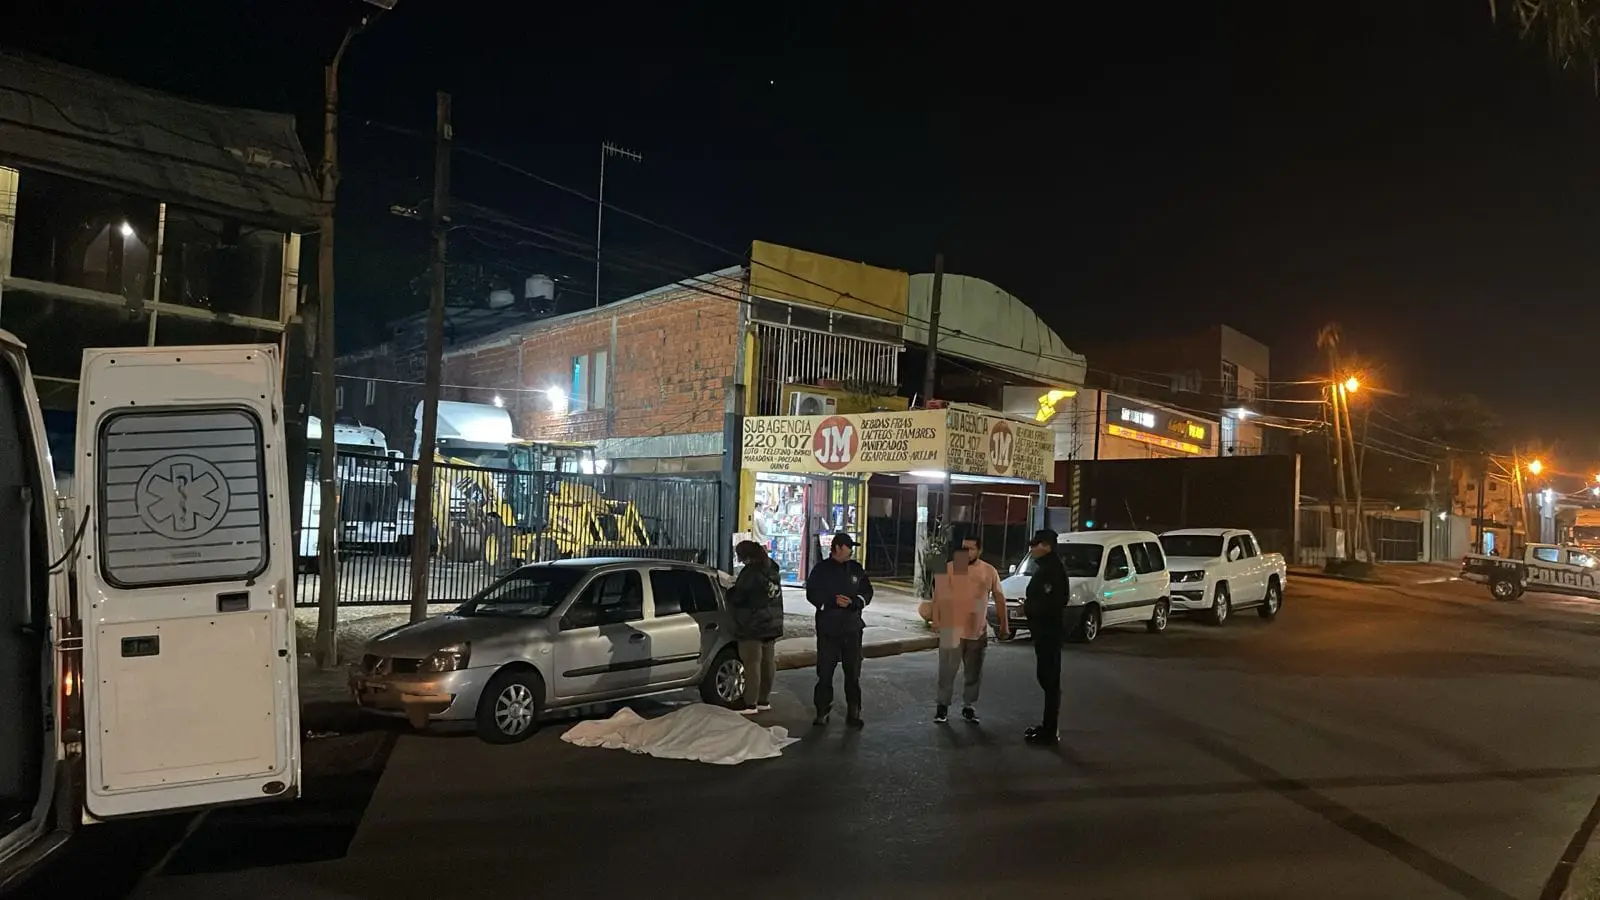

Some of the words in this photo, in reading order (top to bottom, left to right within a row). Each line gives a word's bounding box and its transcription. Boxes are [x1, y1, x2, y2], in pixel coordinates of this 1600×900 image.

[860, 418, 890, 430] BEBIDAS
[890, 417, 913, 429] FRIAS
[744, 433, 777, 448] 220
[781, 434, 811, 449] 107
[861, 429, 893, 440] LACTEOS
[895, 428, 936, 439] FIAMBRES
[950, 433, 966, 449] 220
[968, 435, 981, 451] 107
[815, 425, 853, 464] JM
[991, 431, 1011, 466] JM
[860, 451, 908, 461] CIGARRILLOS
[1528, 566, 1594, 589] POLICIA
